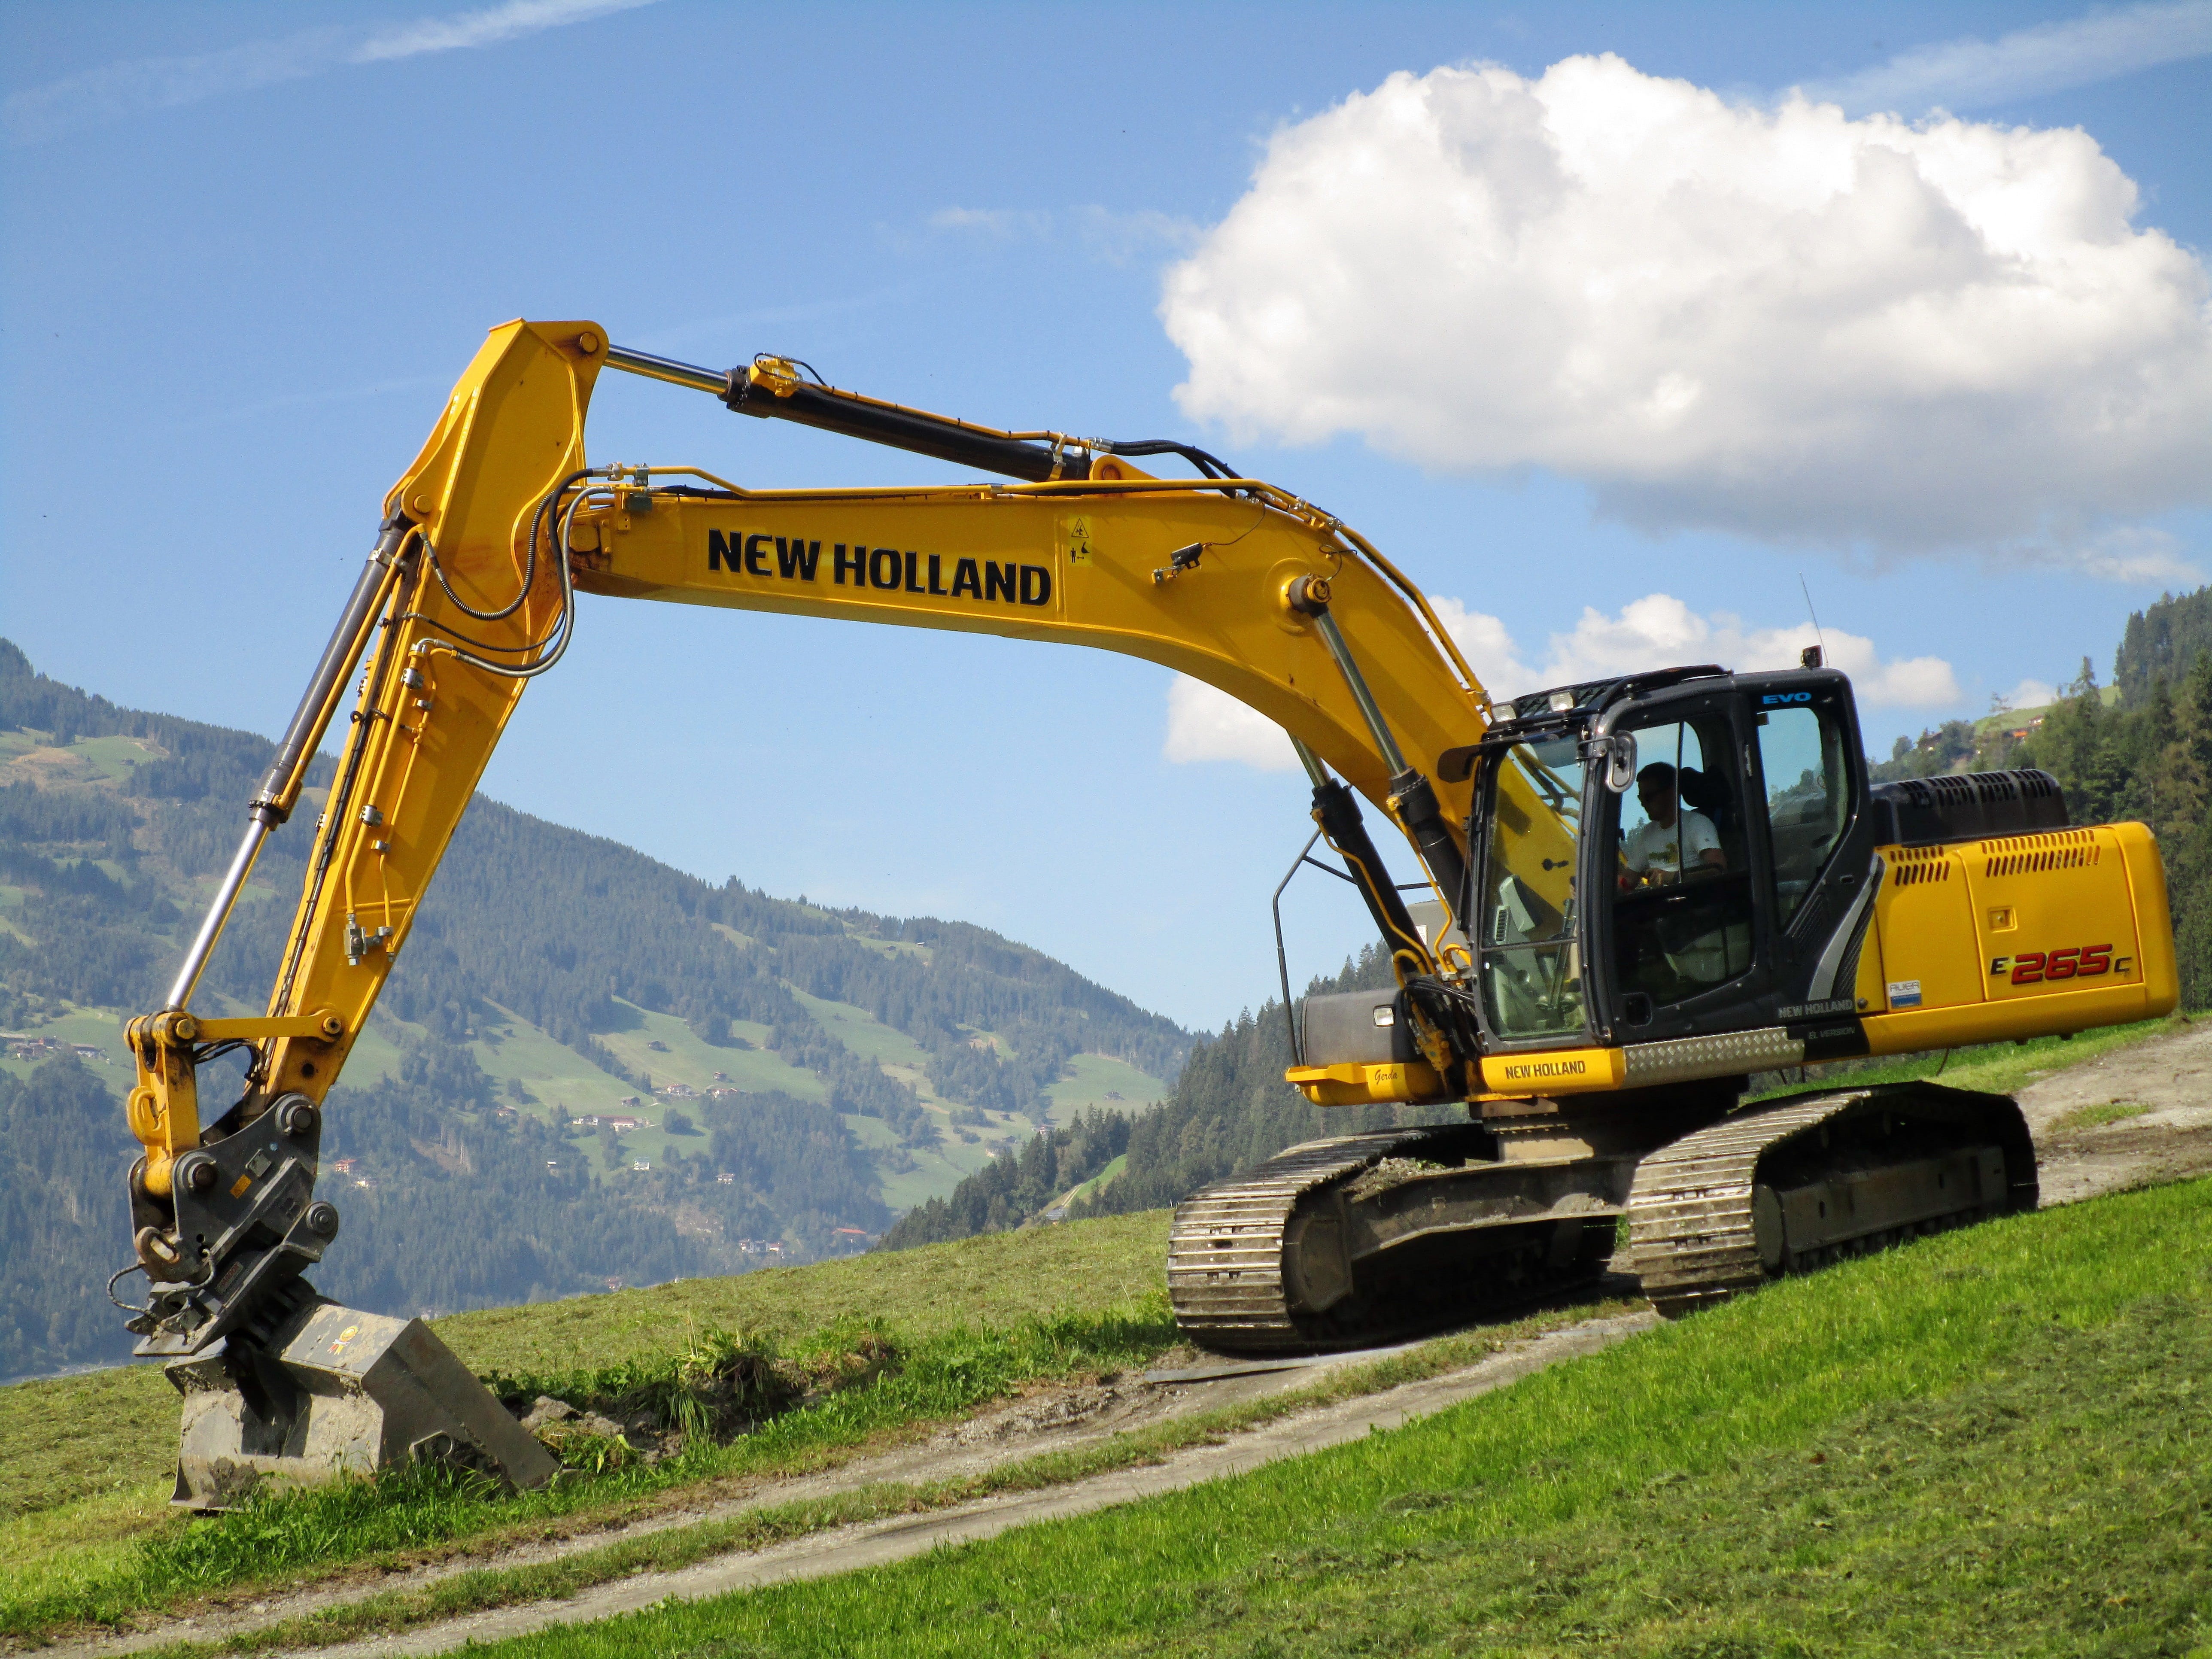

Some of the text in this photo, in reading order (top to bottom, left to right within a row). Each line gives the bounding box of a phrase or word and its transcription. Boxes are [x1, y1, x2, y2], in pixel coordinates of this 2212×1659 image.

[708, 528, 1051, 607] NEW HOLLAND
[1762, 692, 1812, 704] EVO
[1778, 999, 1853, 1018] NEW HOLLAND
[1374, 1069, 1398, 1085] Gerda
[1505, 1060, 1586, 1079] NEW HOLLAND
